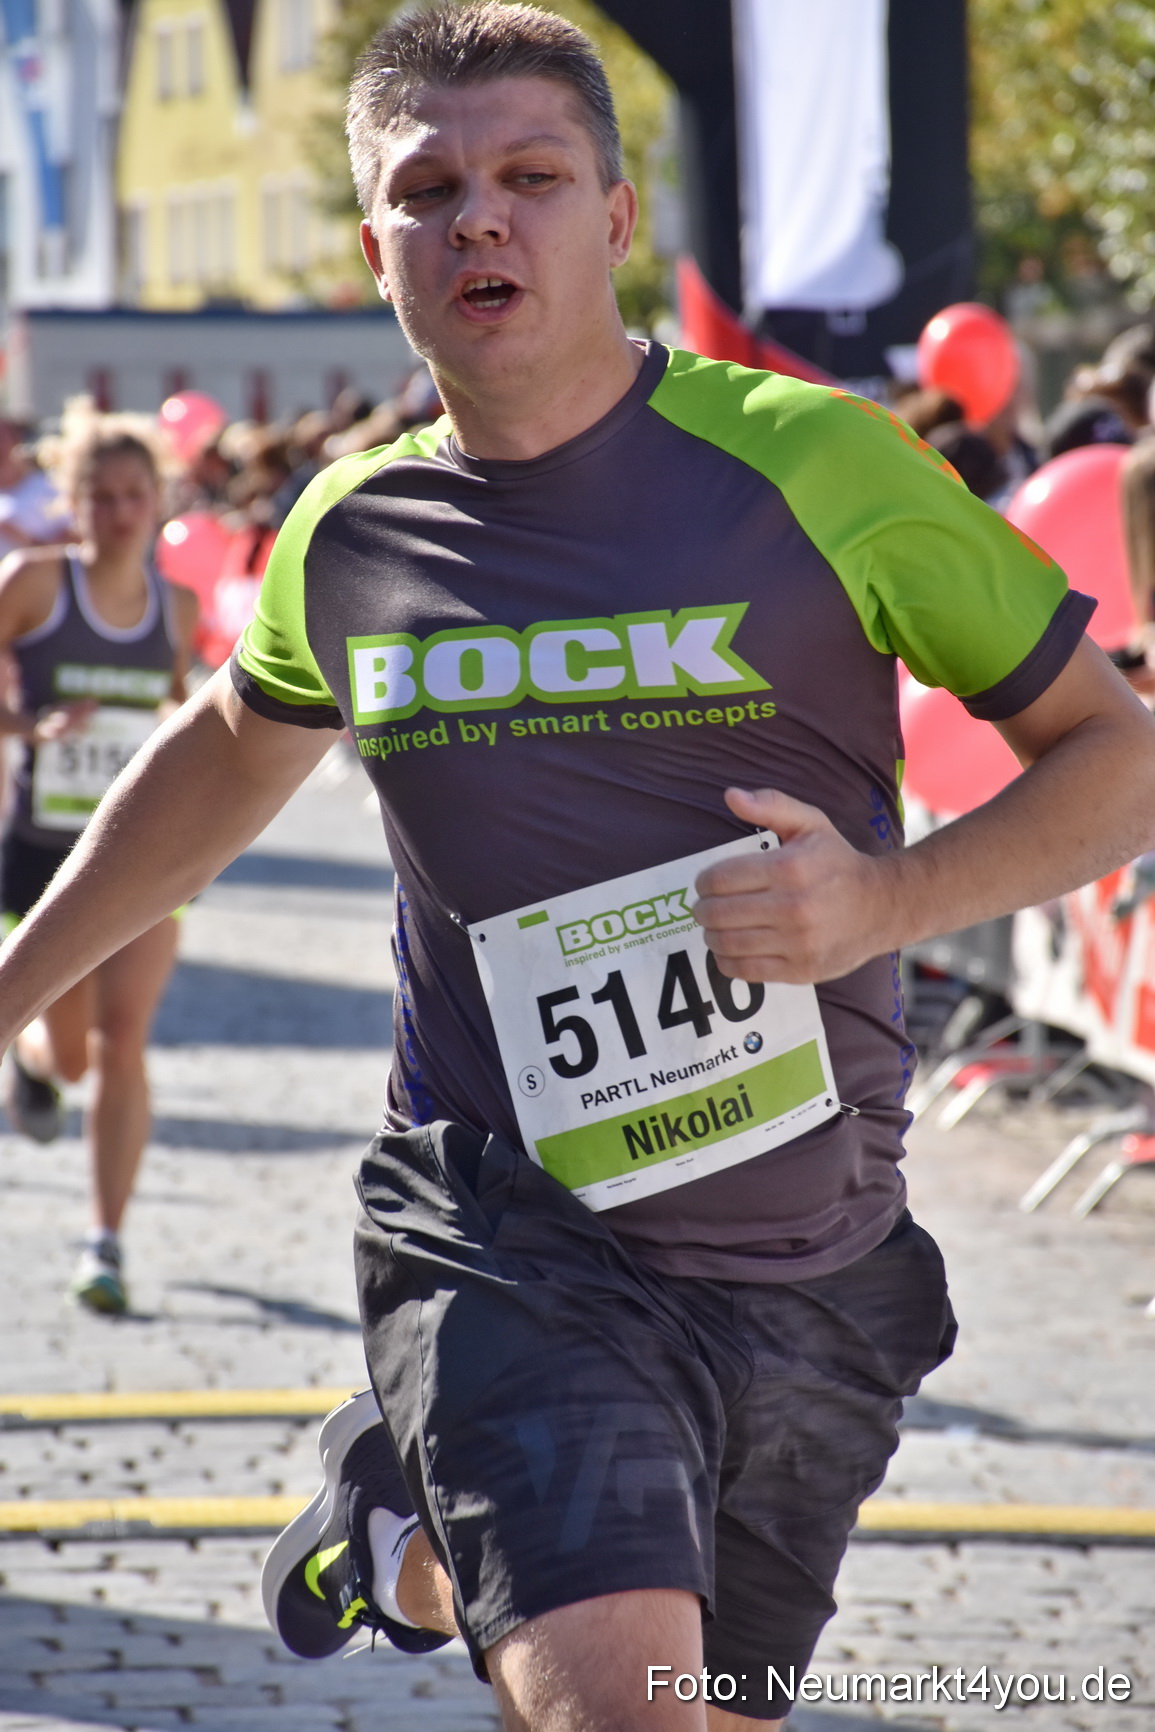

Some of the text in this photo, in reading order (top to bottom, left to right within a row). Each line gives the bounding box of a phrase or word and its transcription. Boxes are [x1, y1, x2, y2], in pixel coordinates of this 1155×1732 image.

[346, 602, 773, 726] BOCK
[356, 700, 777, 761] inspired by smart concepts
[555, 887, 693, 956] BOCK
[564, 920, 701, 968] inspired by smart concept
[536, 949, 765, 1079] 5146
[526, 1073, 537, 1090] S
[580, 1045, 739, 1110] PARTL Neumarkt
[622, 1083, 754, 1161] Nikolai
